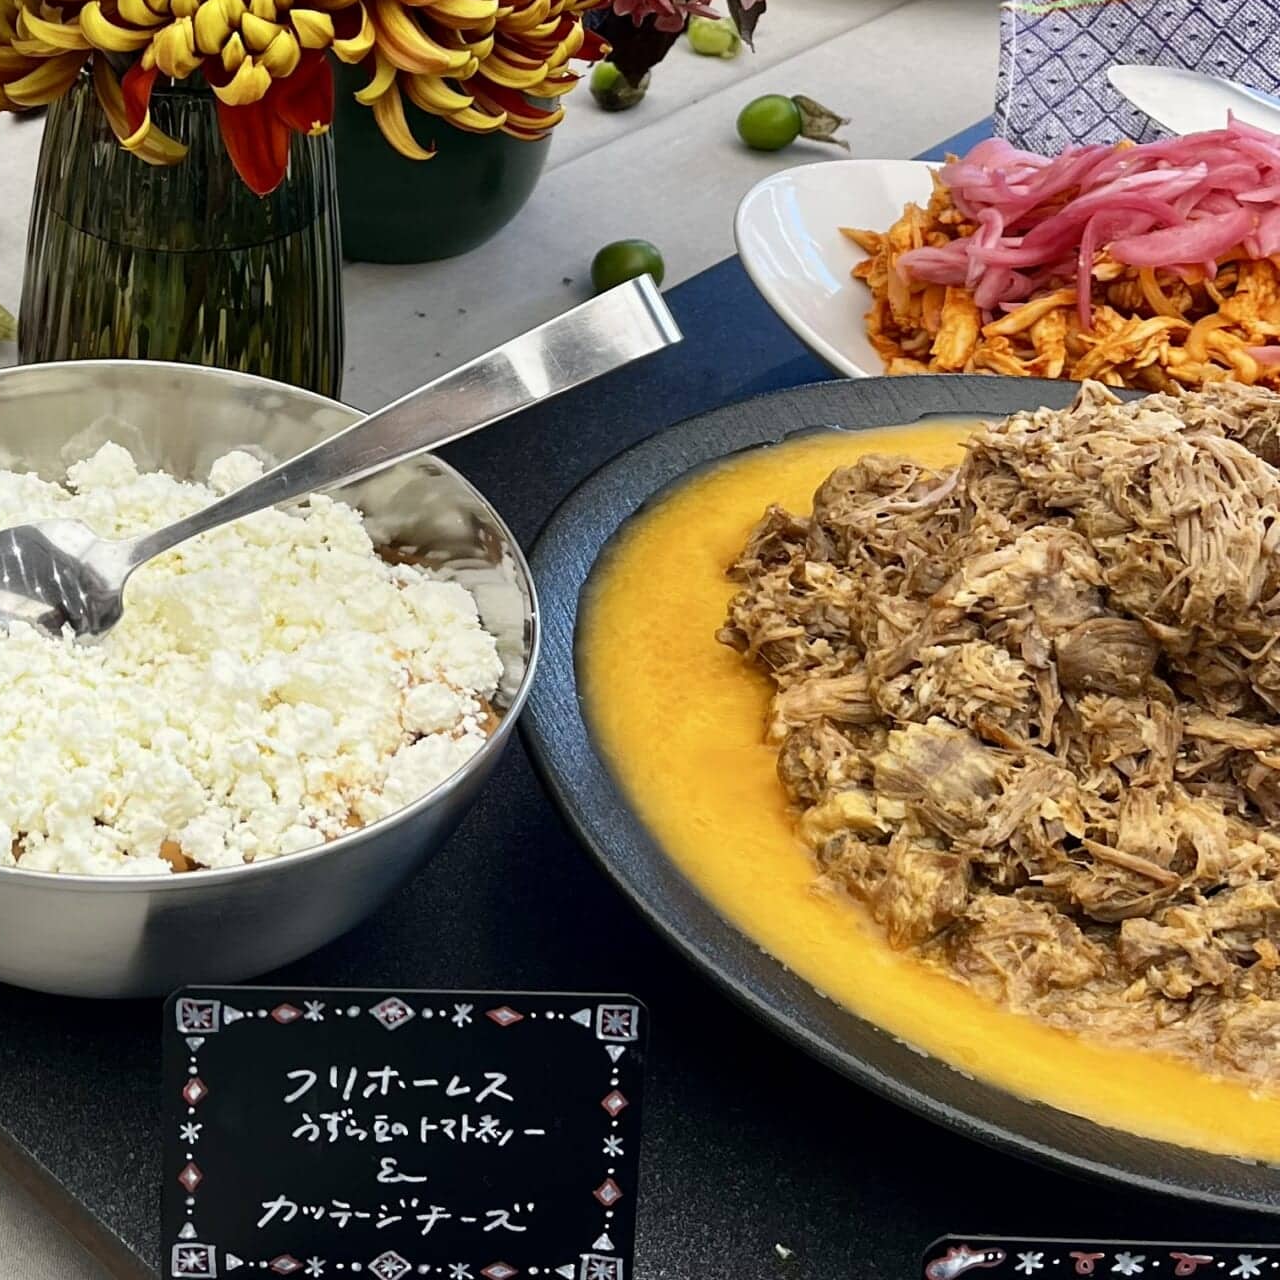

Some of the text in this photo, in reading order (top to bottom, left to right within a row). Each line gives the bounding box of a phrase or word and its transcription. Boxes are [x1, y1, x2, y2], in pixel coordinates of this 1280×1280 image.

[256, 1194, 535, 1236] カッテージチーズ
